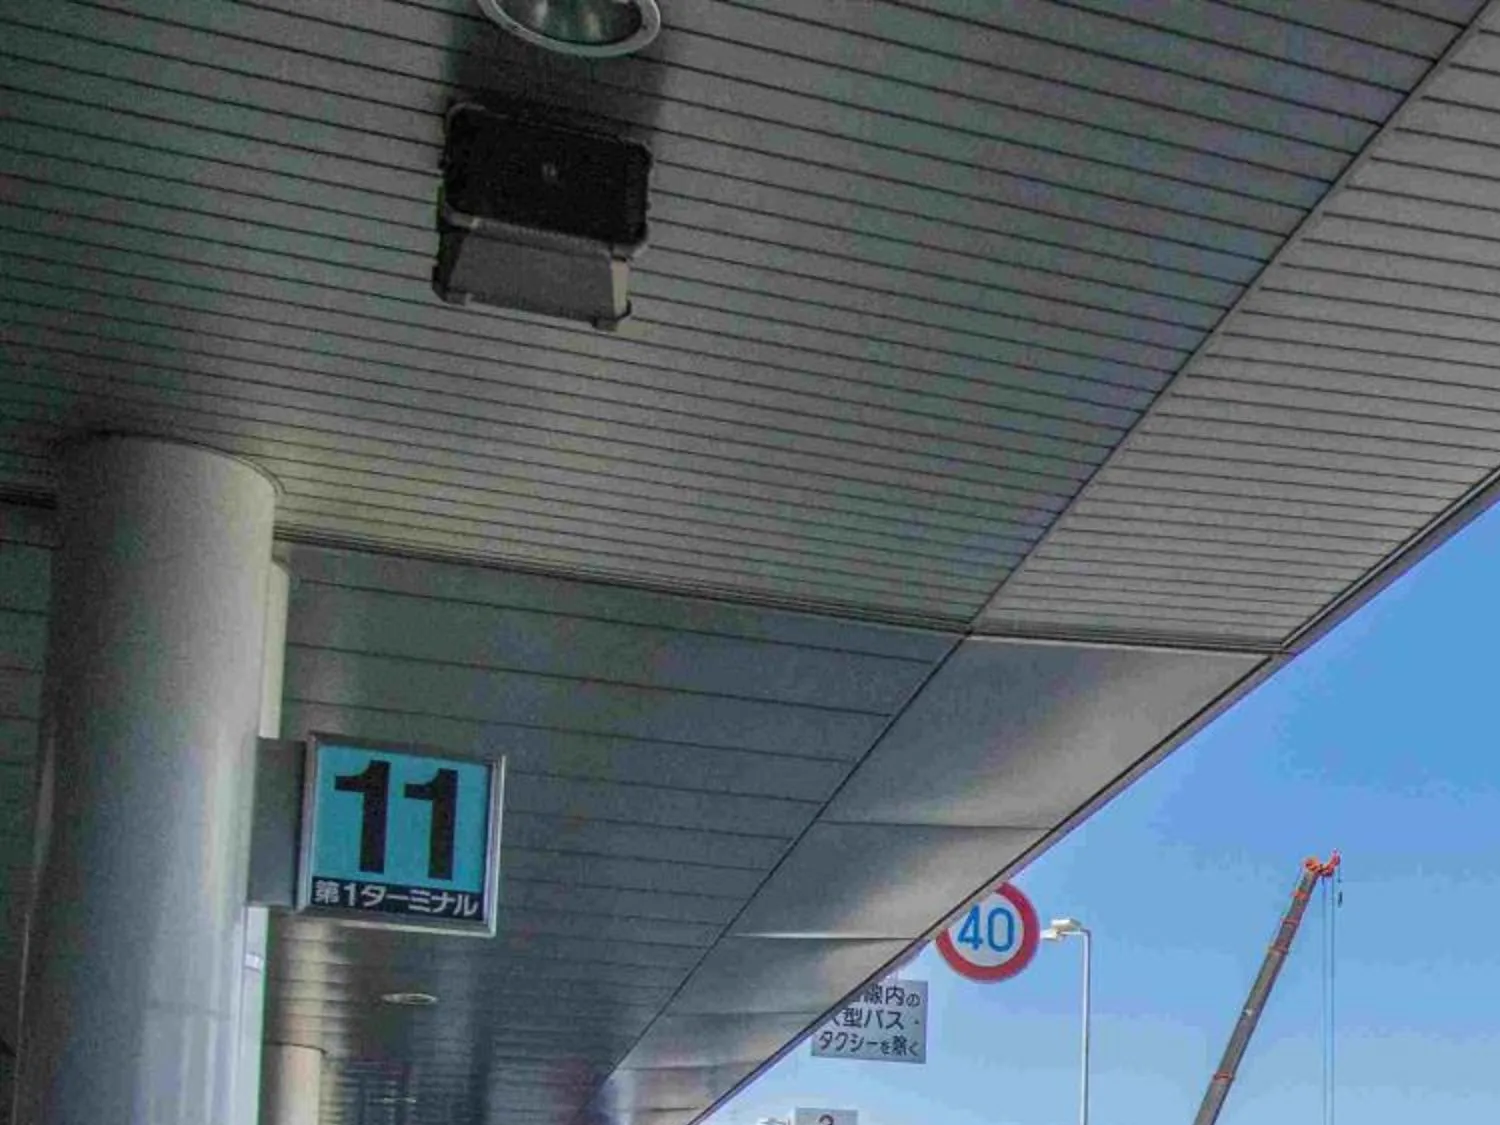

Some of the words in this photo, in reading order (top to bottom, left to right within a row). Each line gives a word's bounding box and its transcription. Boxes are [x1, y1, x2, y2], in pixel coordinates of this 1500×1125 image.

[334, 760, 458, 881] 11
[315, 880, 479, 917] 第1ターミナル
[957, 904, 1015, 953] 40
